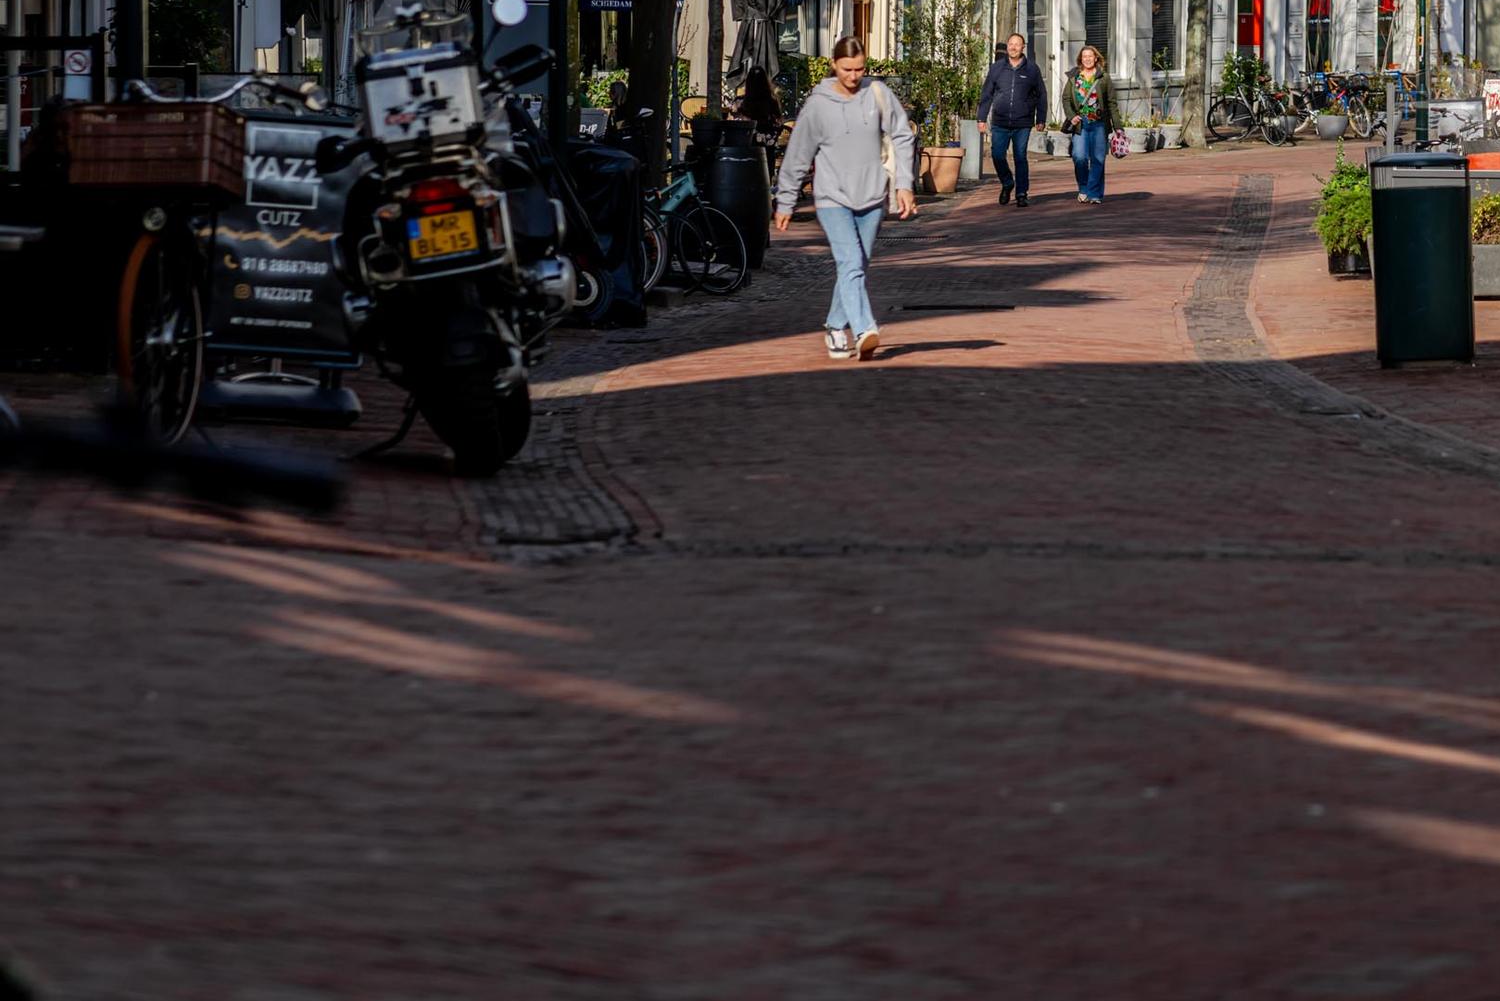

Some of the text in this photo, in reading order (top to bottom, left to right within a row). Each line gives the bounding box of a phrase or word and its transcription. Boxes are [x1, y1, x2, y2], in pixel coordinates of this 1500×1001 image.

[591, 0, 632, 8] SCHIEDAM
[244, 155, 323, 183] YAZZ
[256, 209, 301, 226] CUTZ
[430, 215, 460, 233] MR
[416, 231, 472, 255] BL-15
[253, 286, 313, 302] YAZZCUTZ
